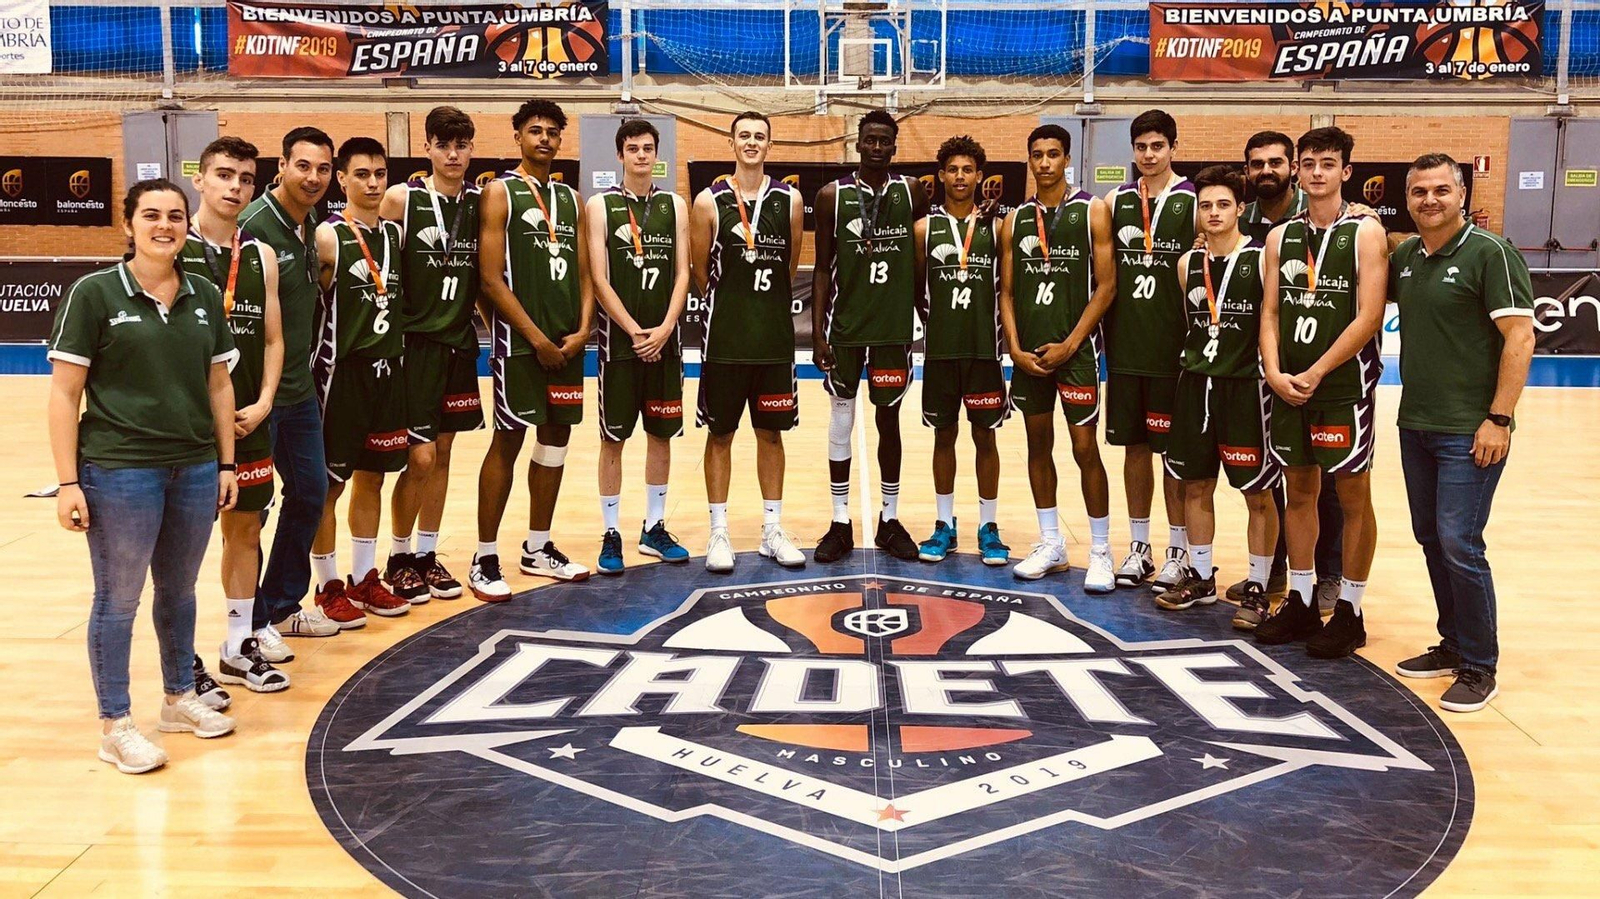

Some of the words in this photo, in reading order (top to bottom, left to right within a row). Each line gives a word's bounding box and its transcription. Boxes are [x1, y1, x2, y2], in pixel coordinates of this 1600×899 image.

[24, 17, 45, 30] DE
[243, 6, 394, 24] BIENVENIDOS
[401, 12, 416, 24] A
[422, 11, 499, 24] PUNTA
[504, 5, 593, 23] UMBRÍA
[1165, 9, 1322, 24] BIENVENIDOS
[1328, 9, 1345, 23] A
[1352, 8, 1429, 23] PUNTA
[1435, 6, 1529, 22] UMBRÍA
[366, 27, 424, 39] CAMPEONATO
[425, 26, 438, 35] DE
[1293, 26, 1352, 40] CAMPEONATO
[1354, 25, 1367, 34] DE
[234, 35, 338, 56] #KDTINF2019
[351, 32, 480, 72] ESPAÑA
[1155, 37, 1263, 58] #KDTINF2019
[1275, 33, 1410, 74] ESPAÑA
[498, 61, 507, 72] 3
[510, 60, 522, 72] al
[526, 61, 537, 72] 7
[538, 60, 555, 72] de
[558, 62, 598, 72] enero
[1426, 63, 1435, 74] 3
[1438, 62, 1450, 74] al
[1455, 63, 1464, 74] 7
[1467, 62, 1485, 73] de
[1489, 63, 1530, 73] enero
[873, 224, 908, 236] Unicaja
[549, 256, 568, 281] 19
[641, 267, 660, 291] 17
[753, 268, 773, 291] 15
[869, 261, 889, 284] 13
[441, 276, 459, 301] 11
[951, 286, 972, 310] 14
[1035, 281, 1055, 305] 16
[1132, 274, 1157, 299] 20
[0, 299, 50, 312] UELVA
[373, 308, 390, 335] 6
[1293, 315, 1318, 345] 10
[1203, 338, 1220, 363] 4
[551, 391, 583, 400] worte
[762, 398, 794, 407] worte
[719, 582, 847, 601] CAMPEONATO
[902, 583, 929, 594] DE
[941, 589, 1023, 606] ESPAÑA
[421, 642, 1348, 741] CADETE
[776, 748, 1003, 769] MASCULINO
[672, 747, 829, 801] HUELVA
[978, 758, 1088, 795] 2019
